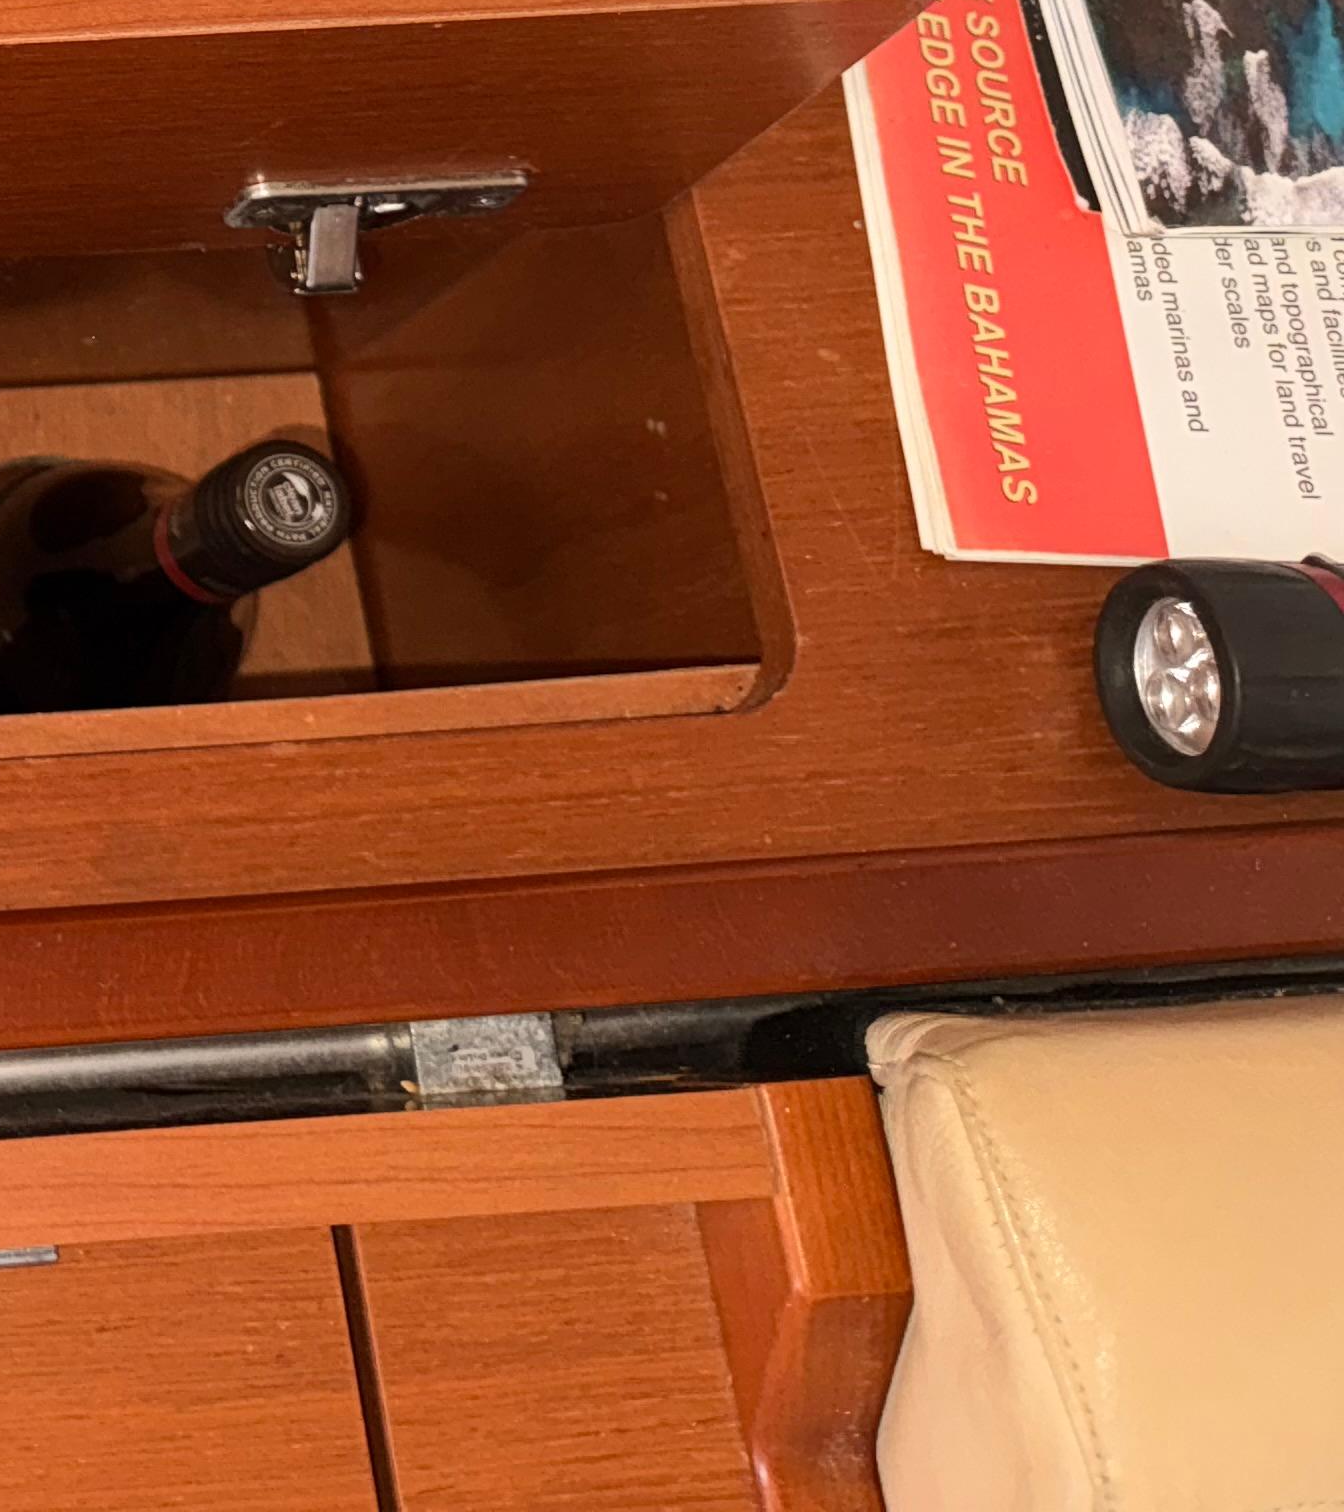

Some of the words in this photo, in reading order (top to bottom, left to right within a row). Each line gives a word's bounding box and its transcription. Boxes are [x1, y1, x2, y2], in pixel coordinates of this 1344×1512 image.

[967, 11, 1029, 188] SOURCE
[935, 133, 975, 182] IN
[946, 186, 995, 277] THE
[1244, 239, 1268, 267] ad
[1126, 239, 1154, 302] amas
[1309, 259, 1336, 301] and
[1221, 276, 1252, 349] scales
[1251, 273, 1280, 336] maps
[1161, 289, 1195, 384] marinas
[1181, 390, 1210, 434] and
[1266, 341, 1289, 373] for
[1279, 280, 1335, 437] topographical
[963, 284, 1039, 507] BAHAMAS
[1275, 378, 1306, 430] land
[1287, 436, 1323, 501] travel
